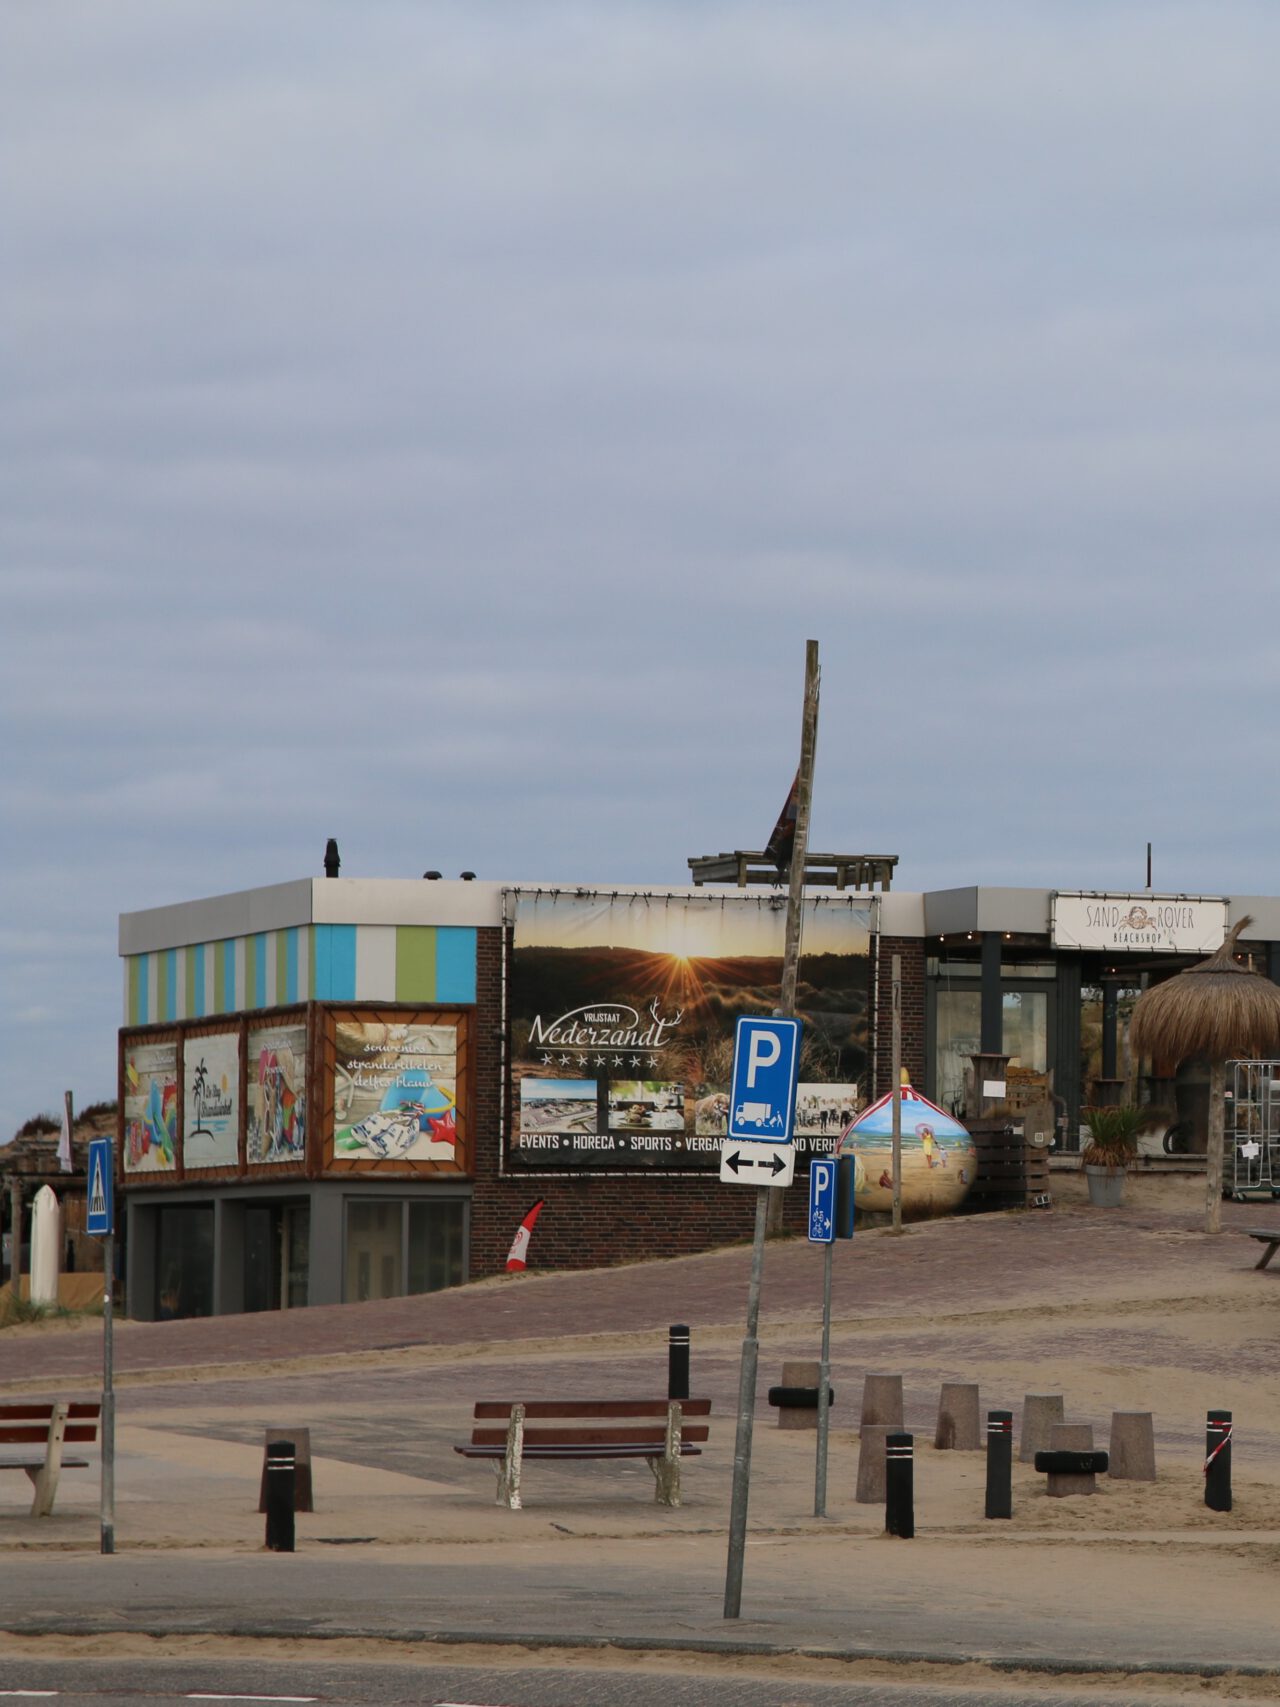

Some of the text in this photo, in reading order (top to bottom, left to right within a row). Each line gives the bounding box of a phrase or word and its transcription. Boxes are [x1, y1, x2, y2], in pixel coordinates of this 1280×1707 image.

[1086, 905, 1194, 929] SAND ROVER
[1113, 932, 1162, 943] BEACHSHOP
[584, 1012, 620, 1023] VRIJSTAAT
[746, 1030, 782, 1088] P
[519, 1134, 559, 1149] EVENTS
[573, 1135, 615, 1150] HORECA
[630, 1136, 672, 1151] SPORTS
[815, 1165, 829, 1206] P
